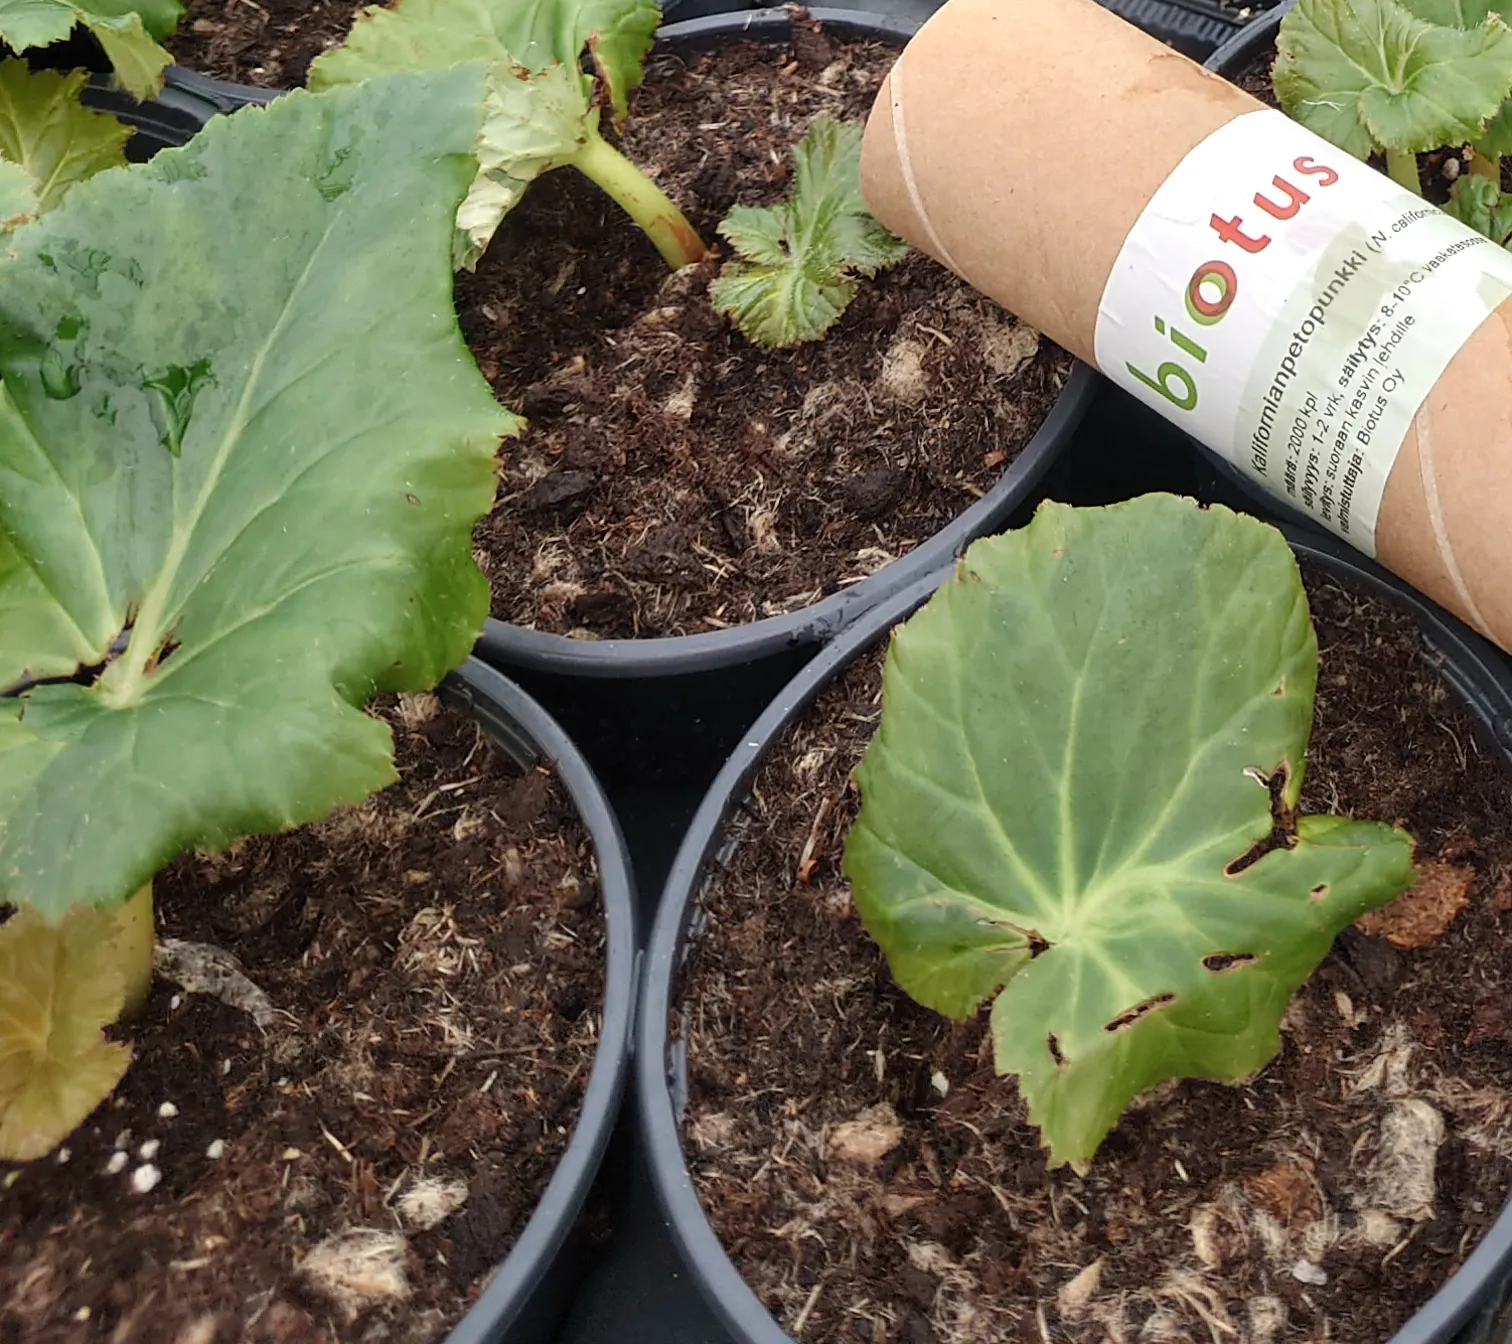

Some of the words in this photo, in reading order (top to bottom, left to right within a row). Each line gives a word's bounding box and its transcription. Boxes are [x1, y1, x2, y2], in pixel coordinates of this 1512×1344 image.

[1125, 155, 1340, 412] biotus
[1251, 249, 1368, 477] Kalifornianpetopunkki
[1365, 230, 1392, 254] (N.
[1373, 314, 1416, 369] lehdille
[1299, 391, 1319, 418] kpl
[1301, 447, 1321, 510] säilyvyys:
[1312, 418, 1330, 445] 1-2
[1324, 392, 1345, 418] vrk,
[1338, 318, 1387, 388] säilytys:
[1380, 271, 1425, 318] 8-10°C
[1345, 366, 1381, 420] kasvin
[1287, 417, 1308, 457] 2000
[1326, 419, 1354, 481] suoraan
[1336, 447, 1365, 534] valmistuttaja:
[1356, 394, 1388, 447] Biotus
[1381, 368, 1405, 394] Oy
[1285, 454, 1299, 498] määrä:
[1320, 479, 1336, 522] levitys:
